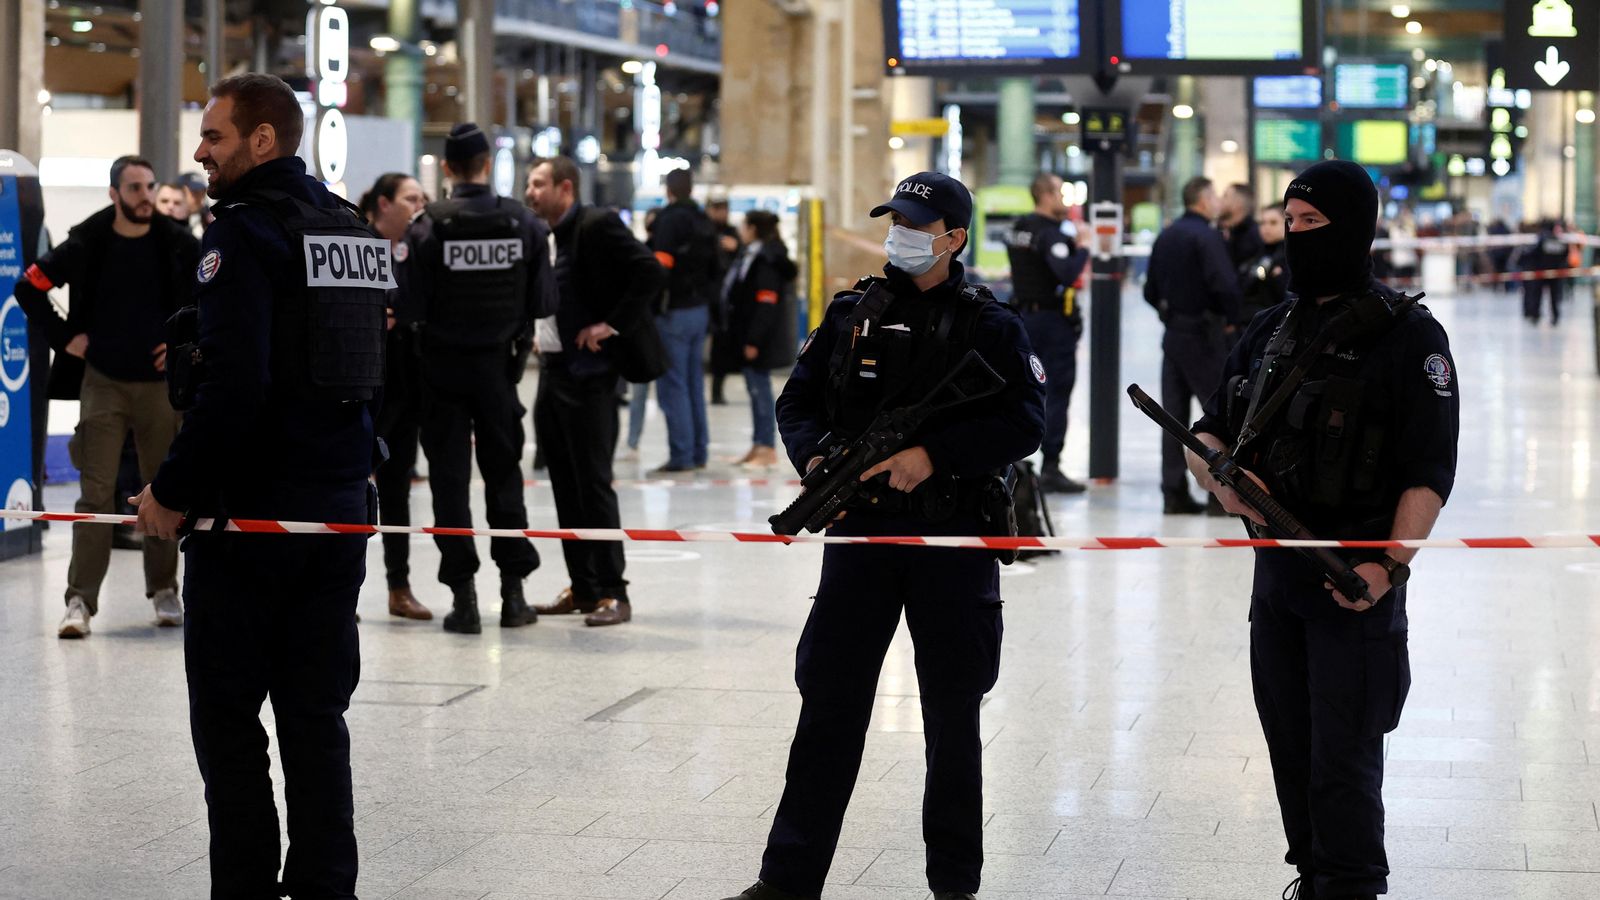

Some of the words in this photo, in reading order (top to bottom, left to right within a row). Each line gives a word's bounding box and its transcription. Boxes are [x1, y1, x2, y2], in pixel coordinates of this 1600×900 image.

[895, 181, 933, 199] POLICE
[309, 242, 389, 282] POLICE
[450, 243, 518, 266] POLICE
